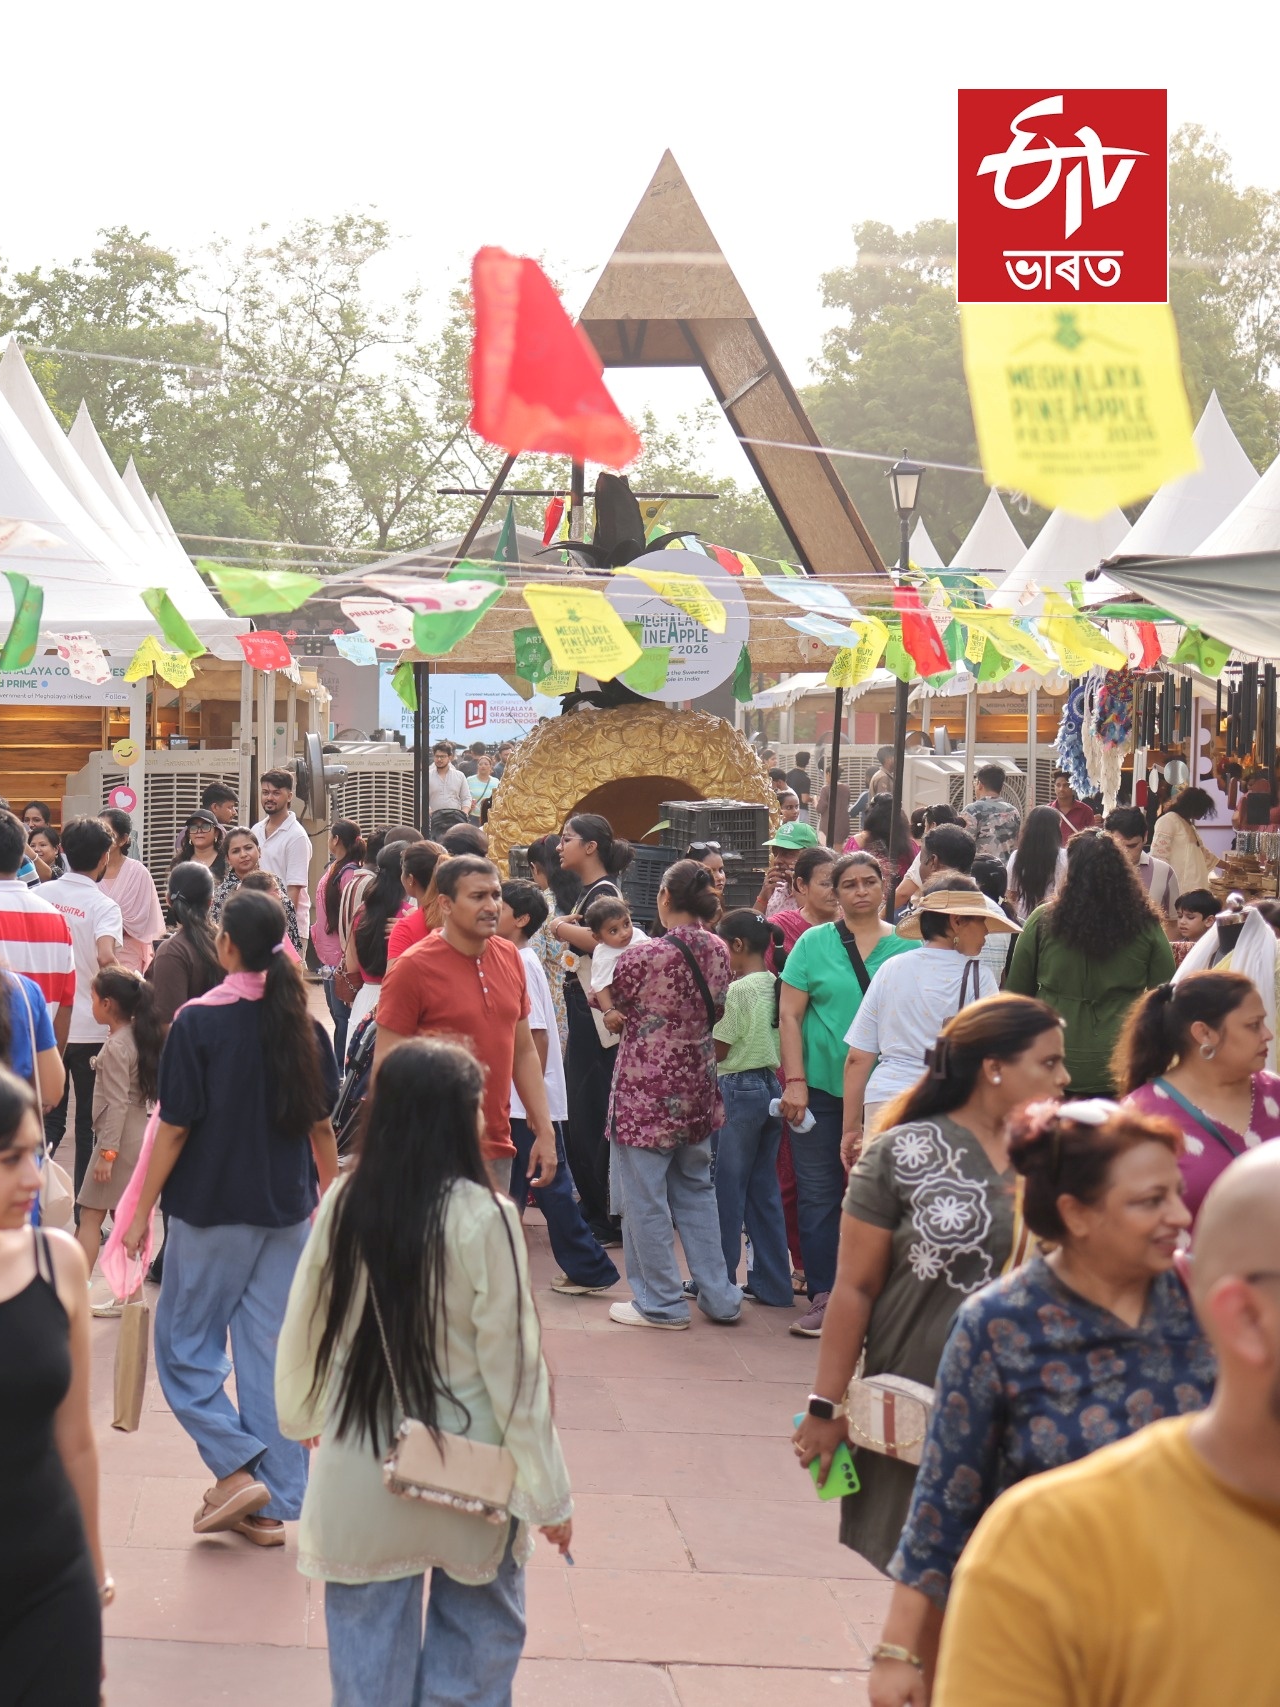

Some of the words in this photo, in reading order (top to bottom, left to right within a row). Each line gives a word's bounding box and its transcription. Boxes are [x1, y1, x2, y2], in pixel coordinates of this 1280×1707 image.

[555, 625, 610, 637] MEGHALAYA
[644, 627, 708, 644] INEAPPLE
[249, 637, 279, 647] MUSIC
[526, 636, 544, 645] ART
[560, 635, 617, 648] PINEAPPLE
[678, 644, 708, 655] 2026
[7, 680, 38, 689] PRIME
[35, 692, 67, 700] Meghalaya
